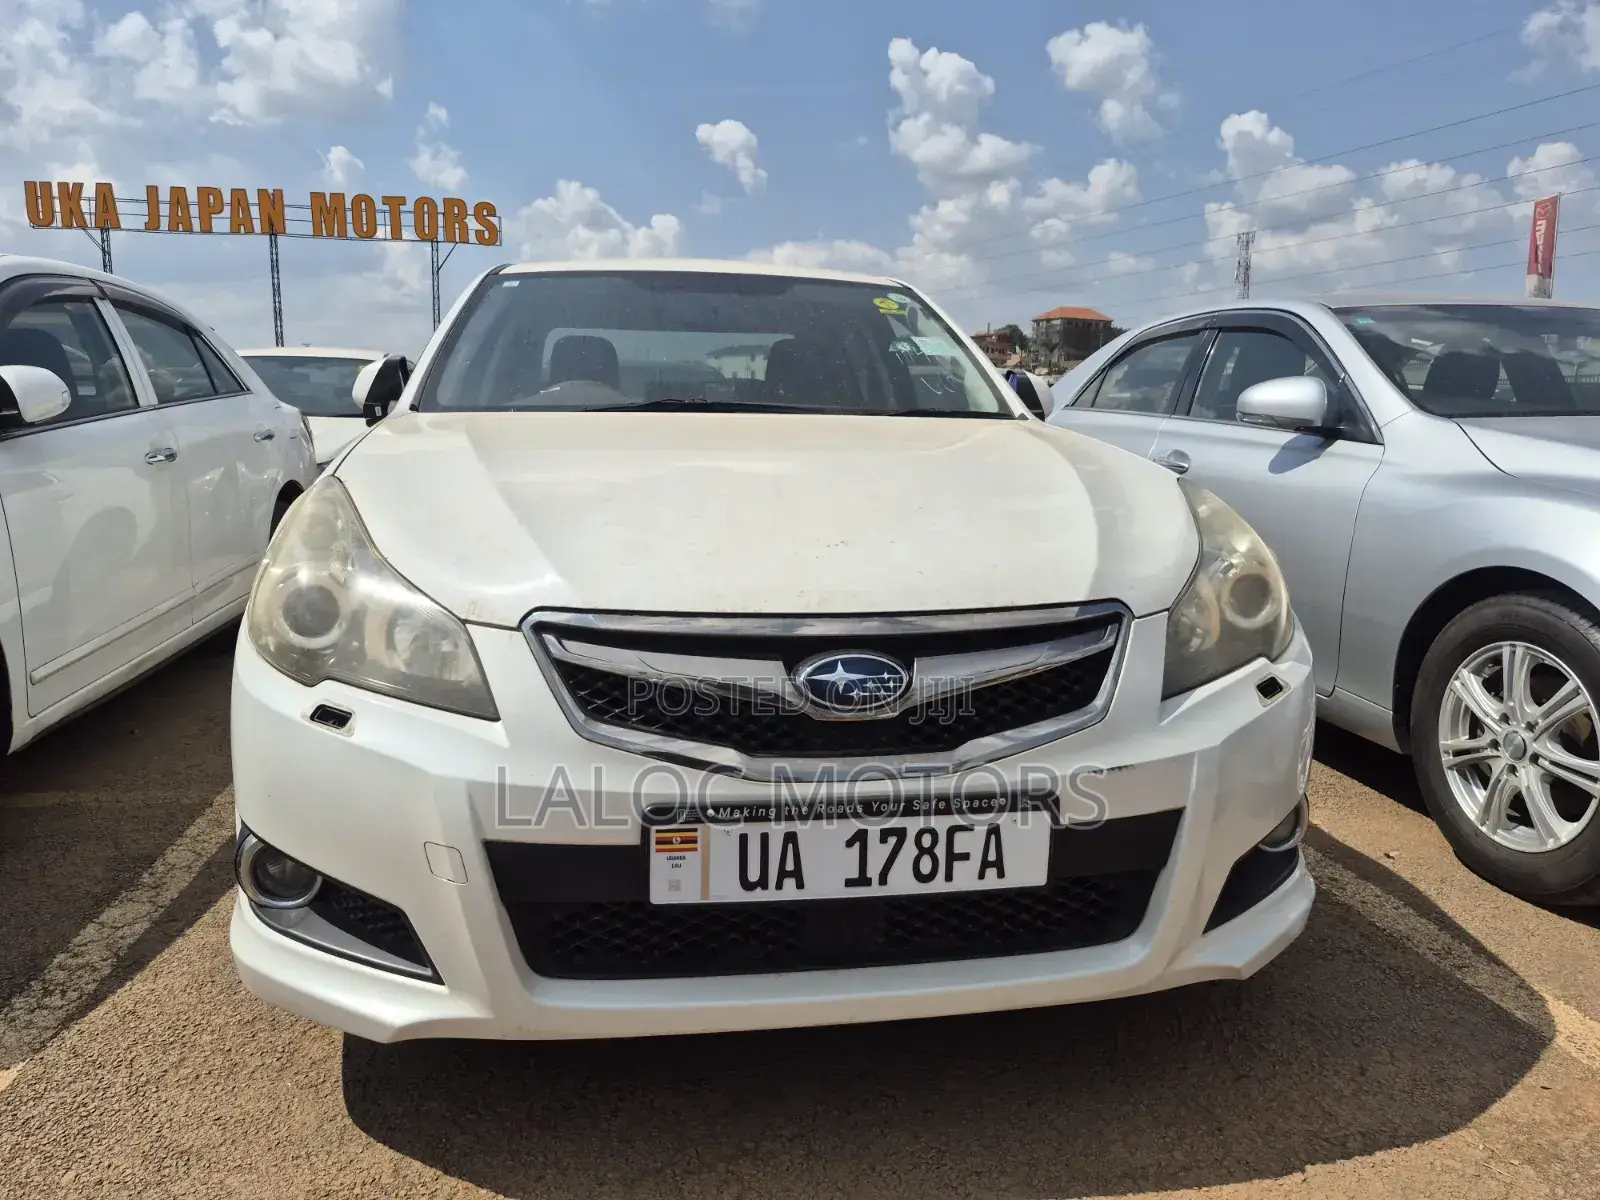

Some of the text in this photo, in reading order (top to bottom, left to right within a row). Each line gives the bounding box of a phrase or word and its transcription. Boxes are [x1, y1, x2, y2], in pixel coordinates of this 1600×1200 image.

[24, 181, 501, 246] UKA JAPAN MOTORS
[718, 807, 777, 819] Making
[784, 805, 808, 815] the
[816, 802, 864, 813] Roads
[871, 801, 906, 812] Your
[912, 799, 946, 810] Safe
[738, 823, 1006, 892] UA 178FA
